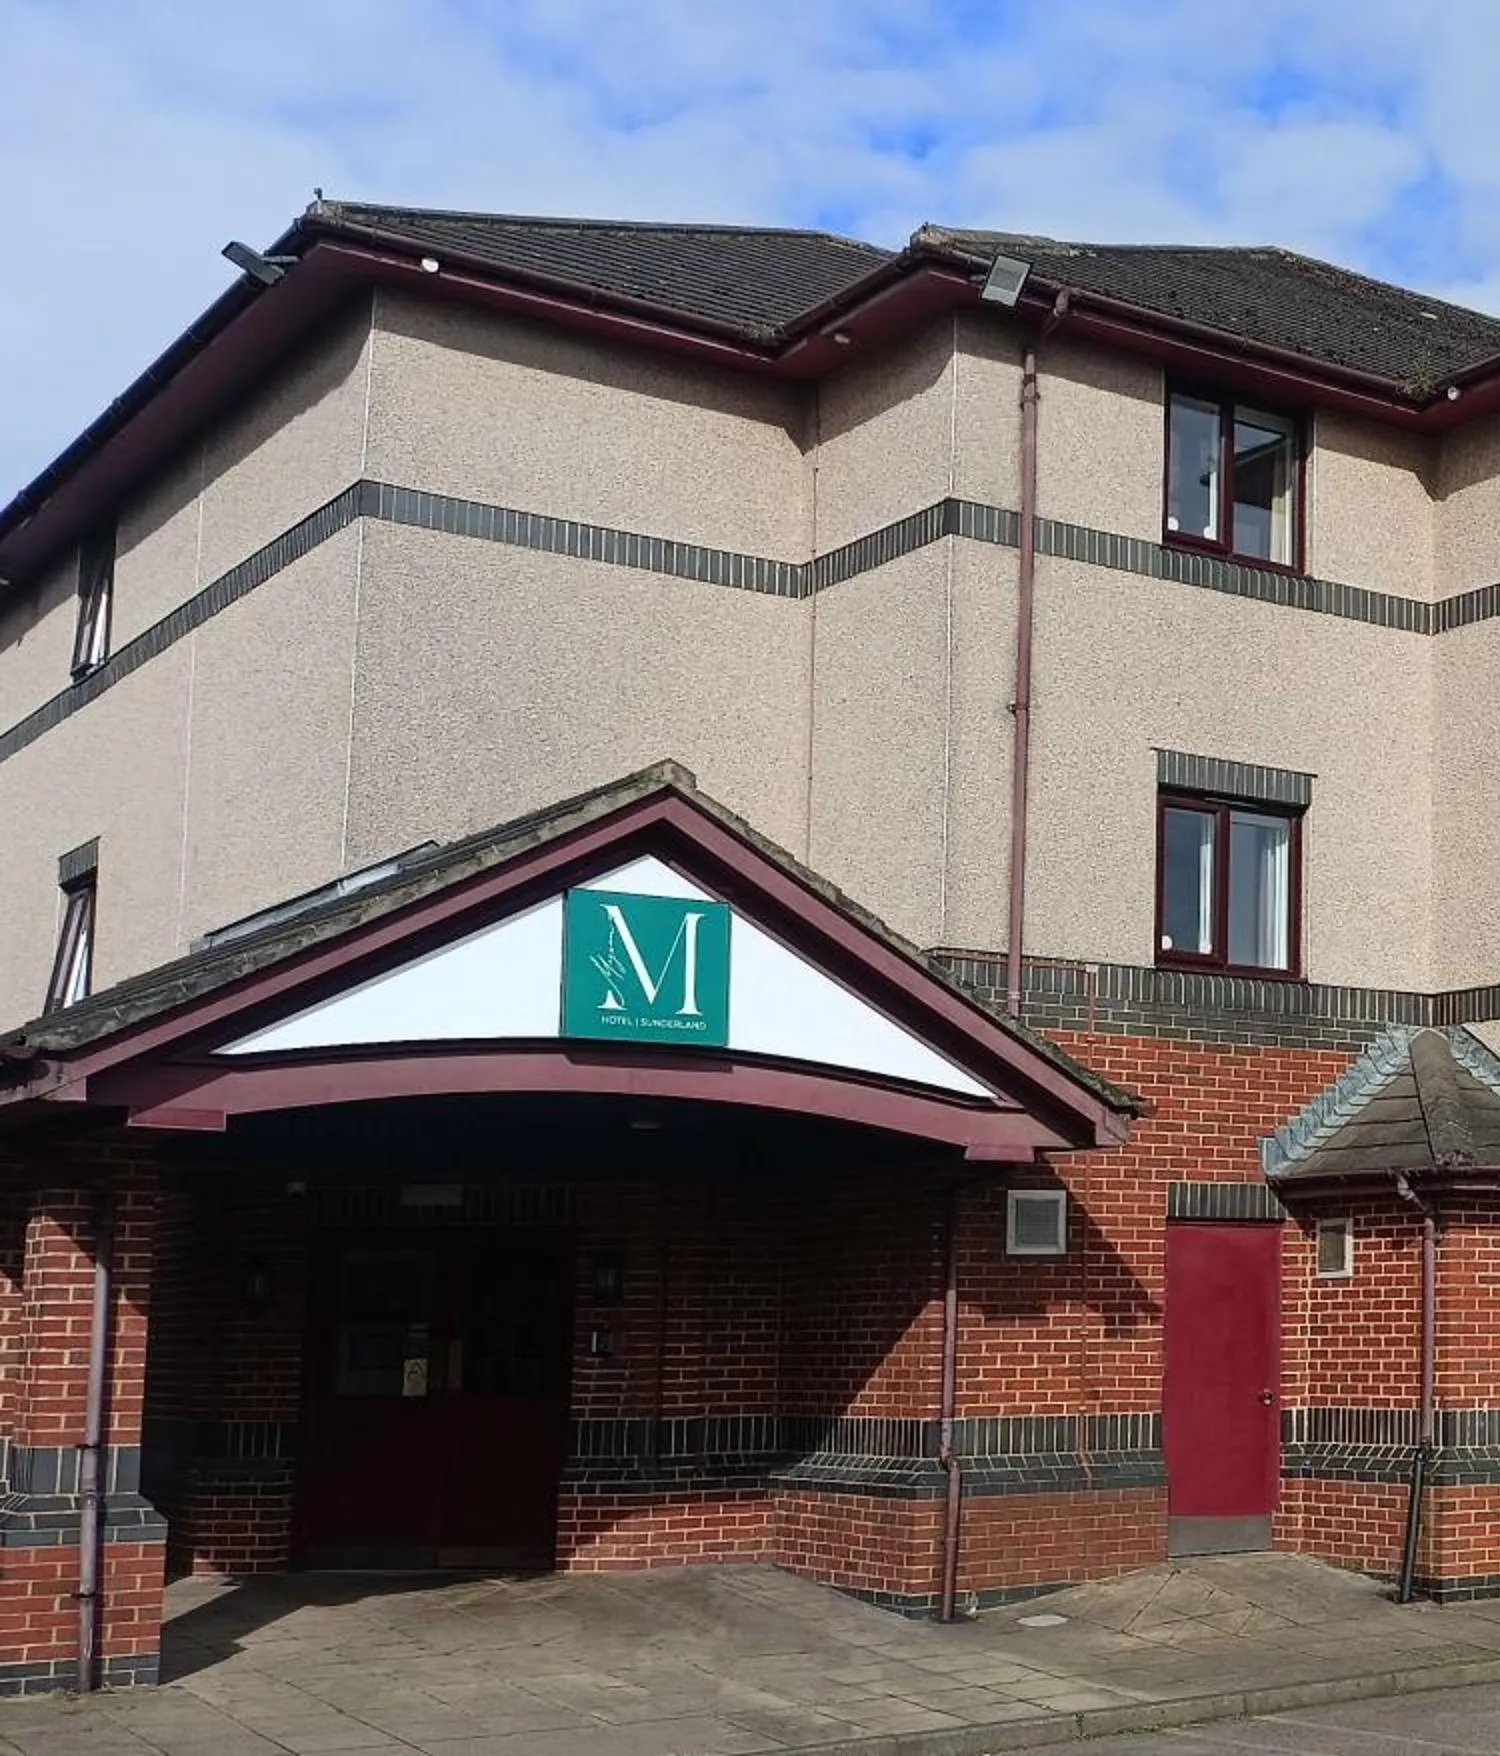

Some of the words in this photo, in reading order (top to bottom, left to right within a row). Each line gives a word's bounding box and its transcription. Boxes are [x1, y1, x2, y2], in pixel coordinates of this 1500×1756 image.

[596, 904, 705, 1016] M
[601, 1015, 633, 1026] HOTEL
[640, 1017, 707, 1031] SUNDERLAND
